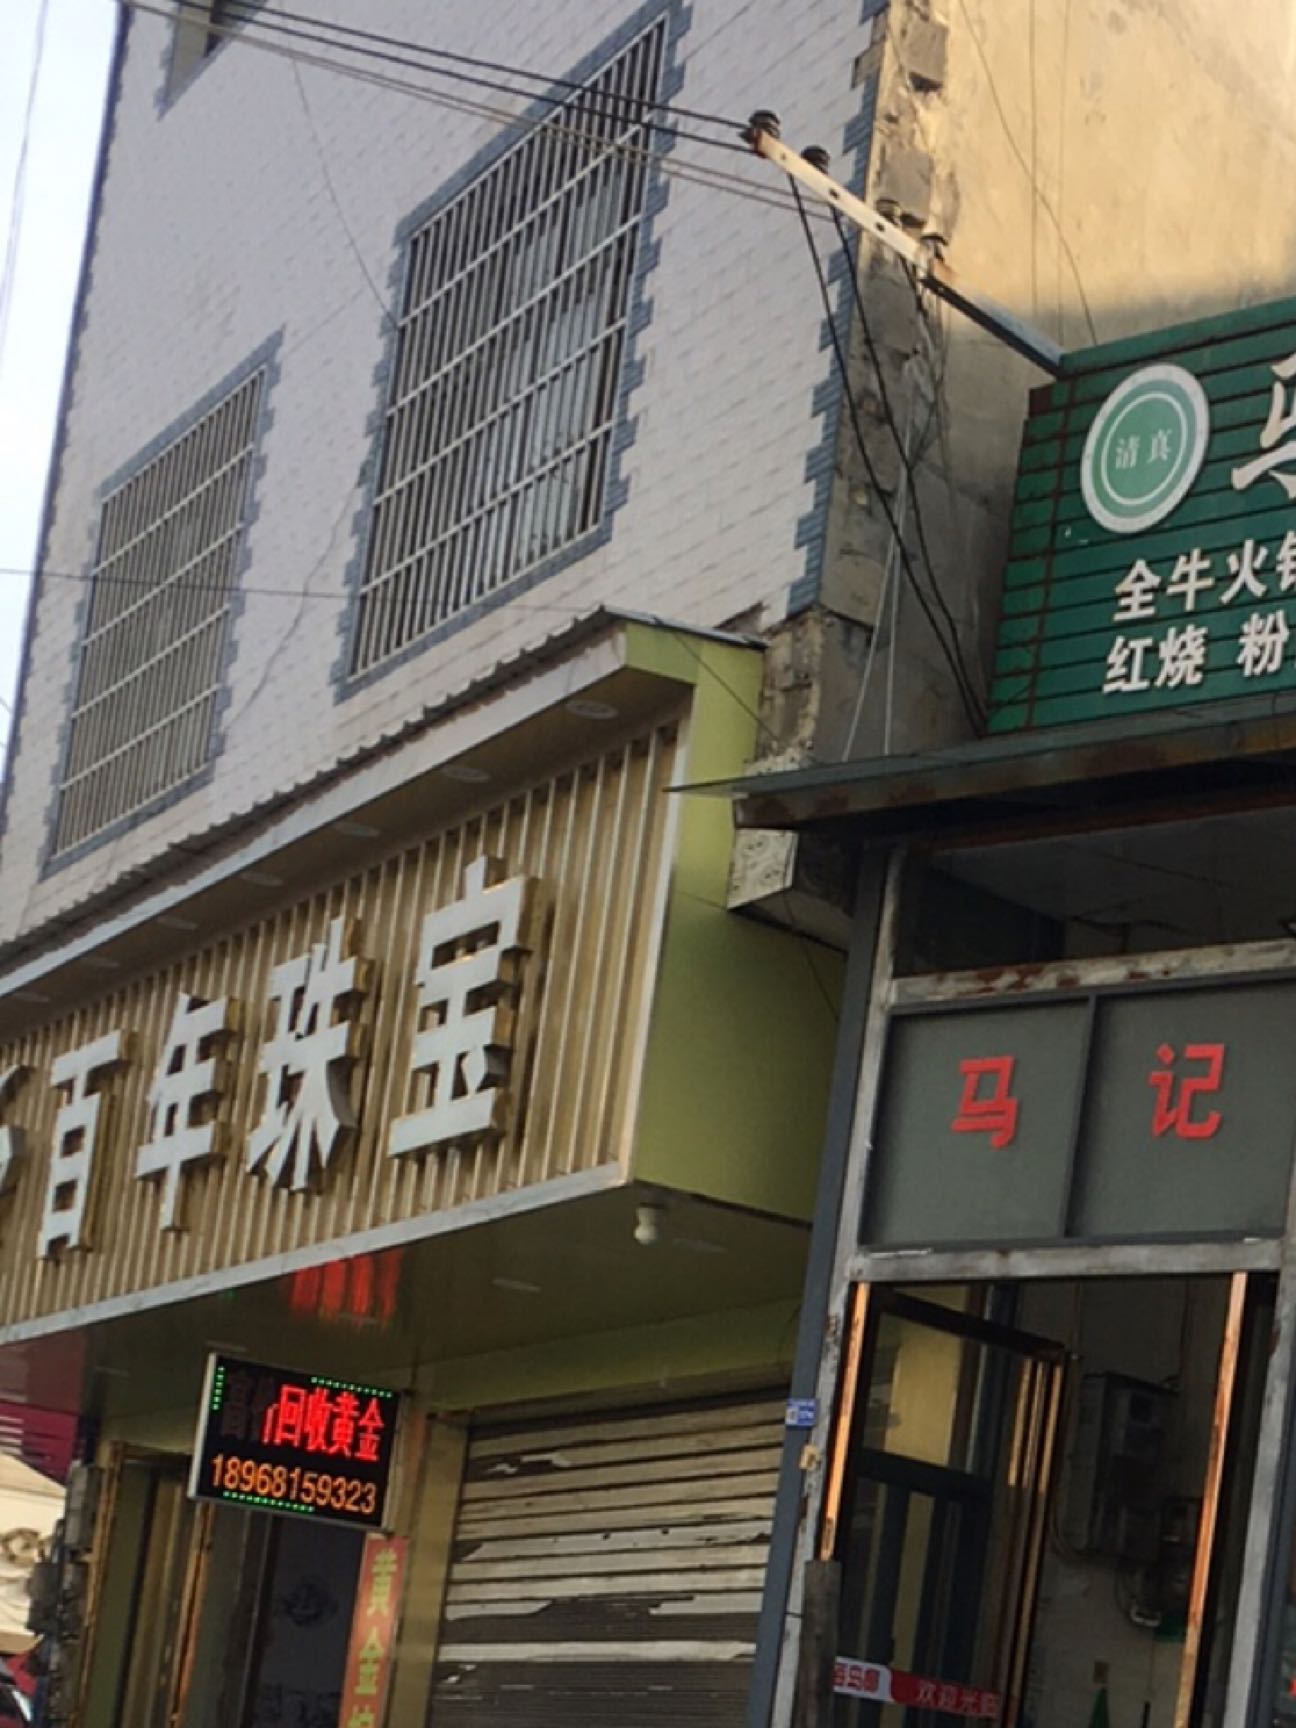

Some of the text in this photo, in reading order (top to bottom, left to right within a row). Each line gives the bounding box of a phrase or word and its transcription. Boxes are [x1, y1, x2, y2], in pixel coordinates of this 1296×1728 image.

[1115, 428, 1173, 470] 清真
[1103, 624, 1208, 694] 红烧
[0, 855, 528, 1262] 百年珠宝
[211, 1453, 376, 1514] 18968159323
